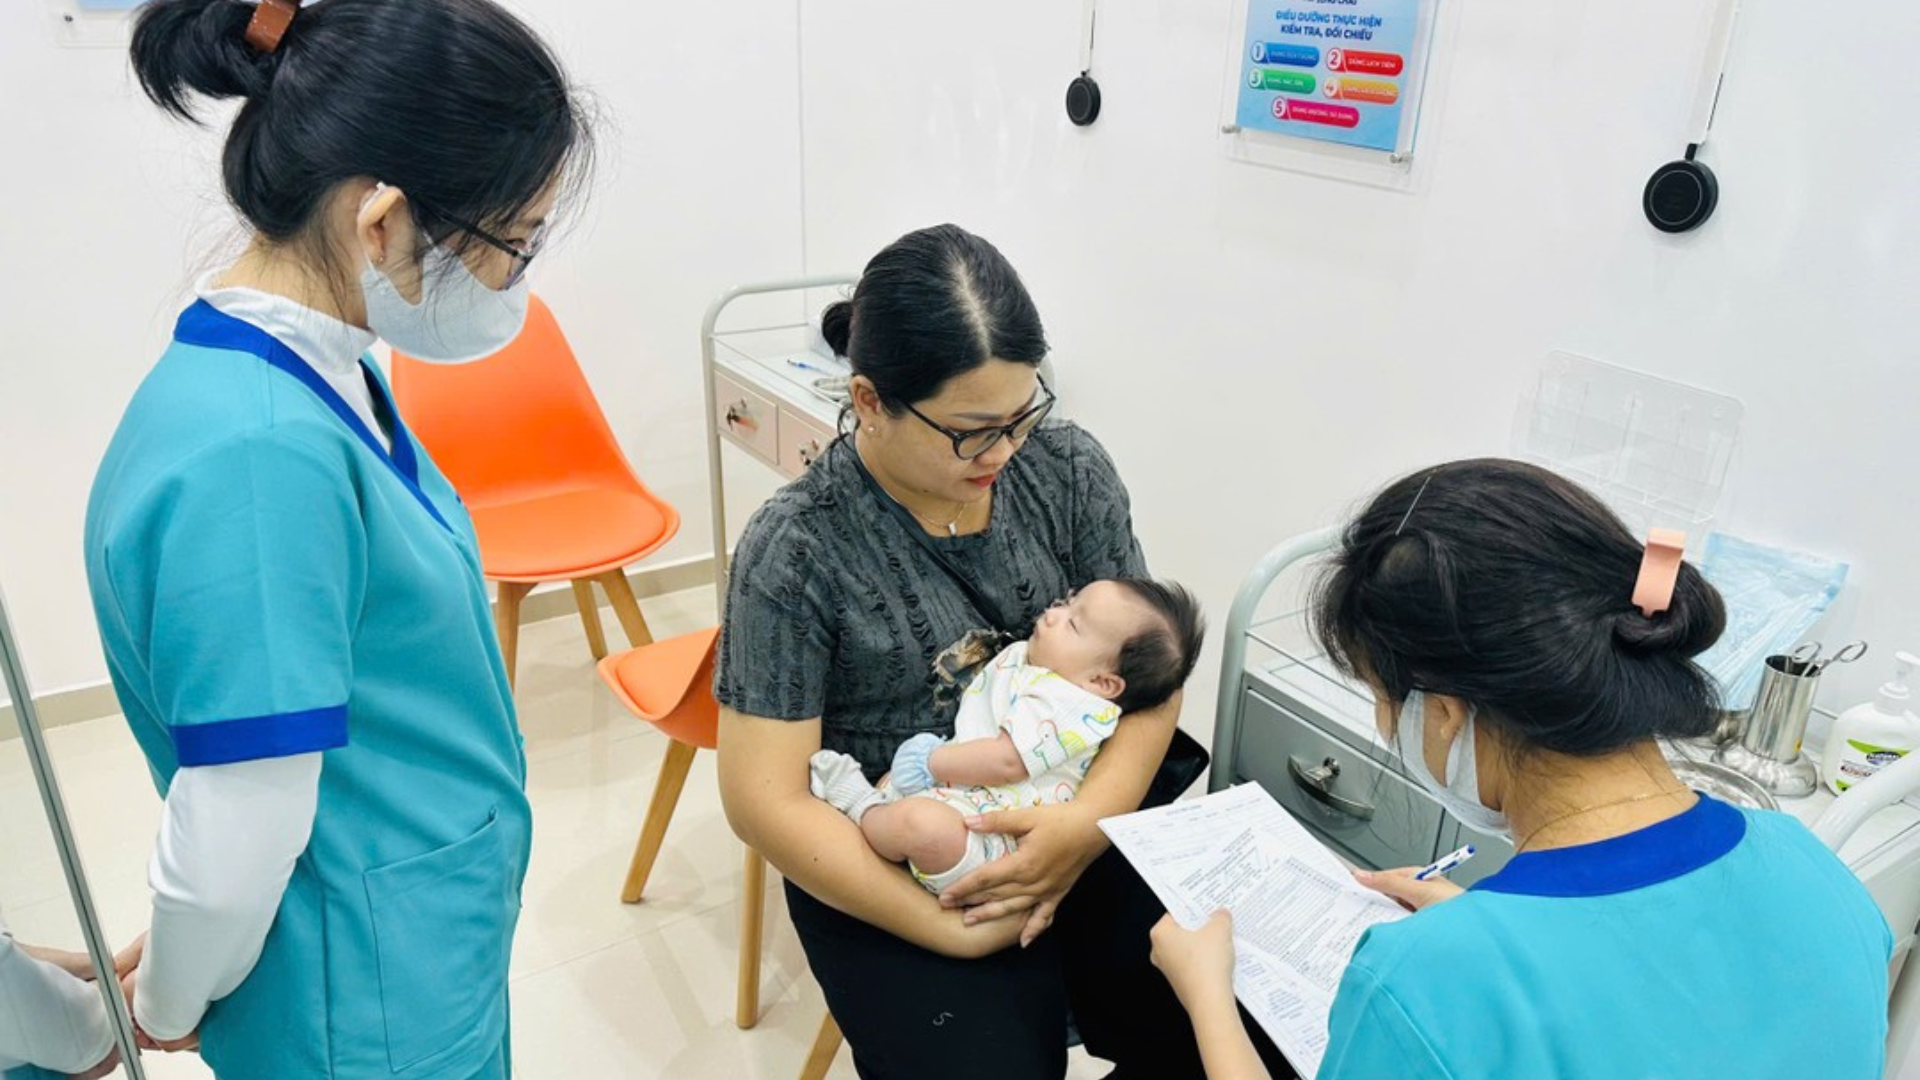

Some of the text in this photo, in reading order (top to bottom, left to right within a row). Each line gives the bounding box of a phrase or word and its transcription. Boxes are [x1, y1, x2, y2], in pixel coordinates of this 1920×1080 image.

[1304, 26, 1323, 38] TRA,
[1330, 51, 1338, 65] 2
[1251, 71, 1259, 85] 3
[1275, 100, 1283, 114] 5
